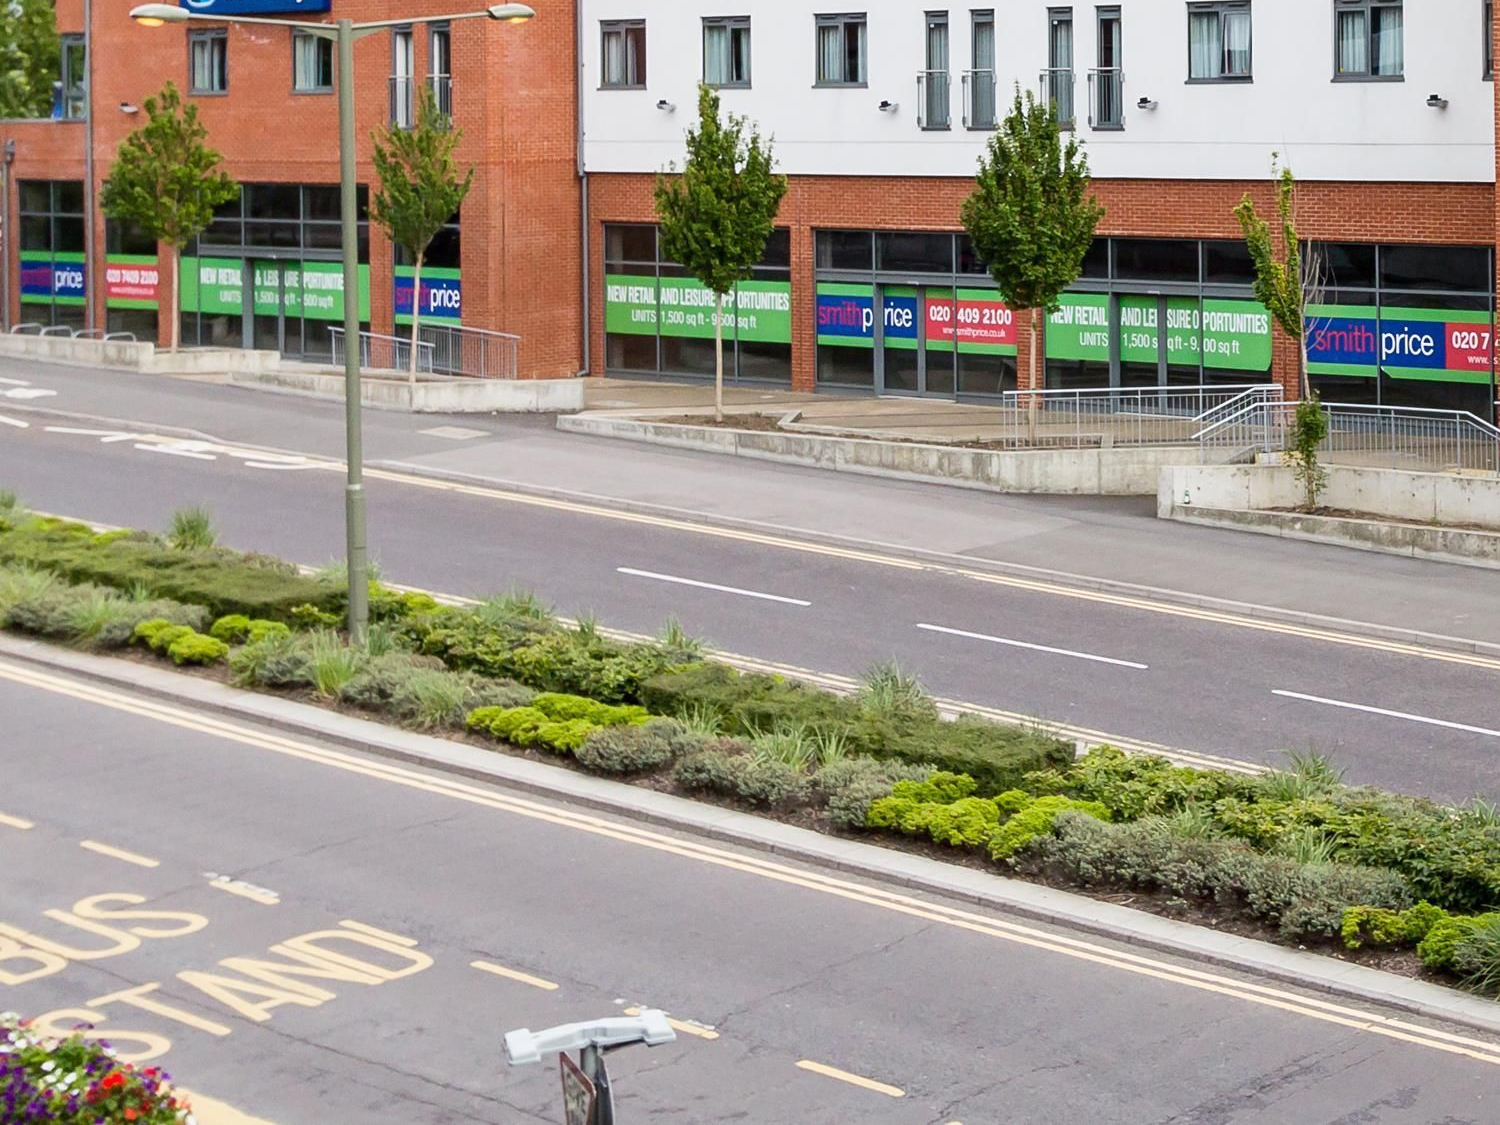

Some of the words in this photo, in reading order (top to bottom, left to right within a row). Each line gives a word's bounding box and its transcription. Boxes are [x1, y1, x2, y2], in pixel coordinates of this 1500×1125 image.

[607, 285, 627, 302] NEW
[628, 286, 657, 305] RETAIL
[660, 287, 679, 305] AND
[680, 288, 716, 307] LEISURE
[720, 289, 789, 311] PPORTUNITIES
[631, 309, 657, 323] UNITS
[661, 310, 685, 325] 1,500
[686, 313, 696, 327] sq
[698, 312, 704, 325] ft
[737, 316, 748, 330] sq
[751, 316, 757, 329] ft
[929, 305, 951, 322] 020
[952, 307, 980, 323] 409
[982, 308, 1012, 325] 2100
[1051, 305, 1074, 325] NEW
[1075, 306, 1108, 326] RETAIL
[1121, 307, 1141, 326] AND
[1143, 308, 1191, 329] LEISURE
[1192, 310, 1268, 335] OPORTUNITIES
[1079, 332, 1108, 347] UNITS
[1123, 333, 1150, 349] 1,500
[1152, 337, 1174, 352] sq
[1175, 336, 1182, 350] ft
[1190, 336, 1216, 353] 9,00
[1218, 341, 1230, 356] sq
[1232, 340, 1240, 354] ft
[1452, 331, 1479, 349] 020
[34, 930, 435, 1062] STAND
